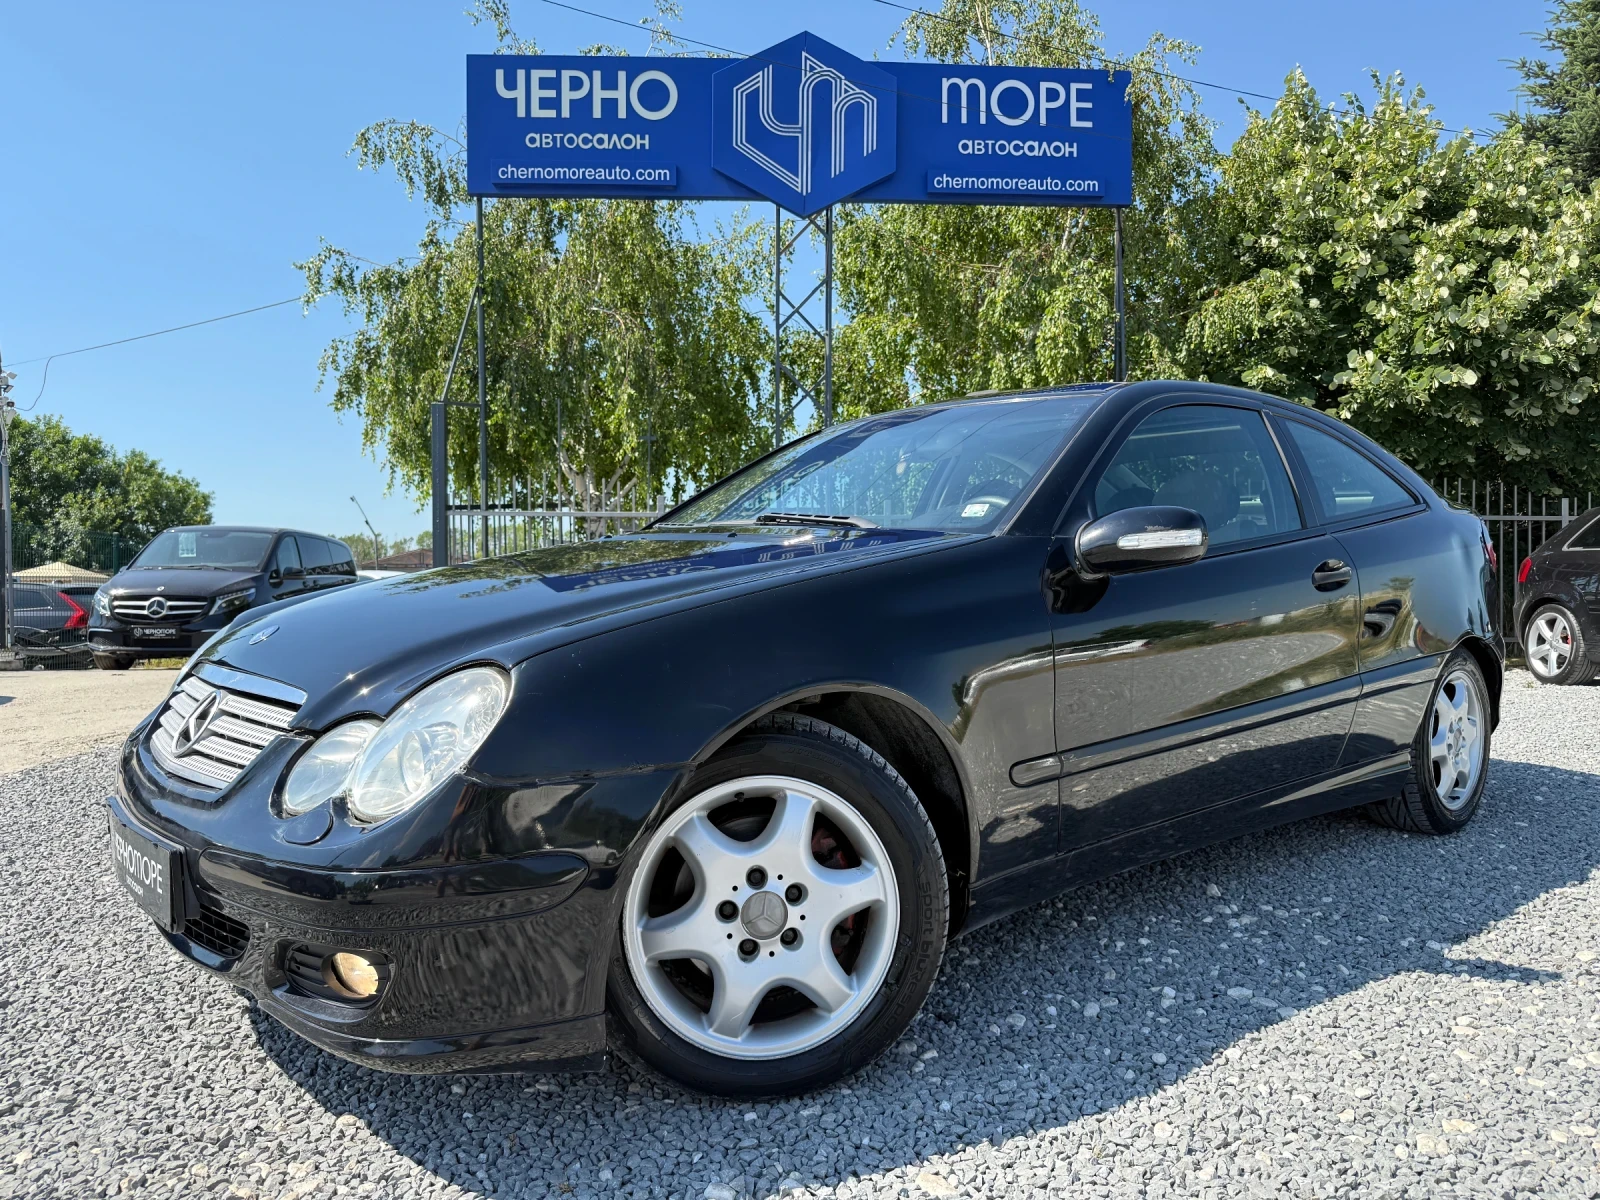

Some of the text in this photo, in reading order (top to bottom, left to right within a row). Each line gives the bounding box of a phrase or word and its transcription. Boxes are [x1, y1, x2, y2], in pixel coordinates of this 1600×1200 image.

[495, 68, 678, 121] ЧЕРНО
[498, 164, 670, 181] chernomoreauto.com
[933, 173, 1099, 192] chernomoreauto.com
